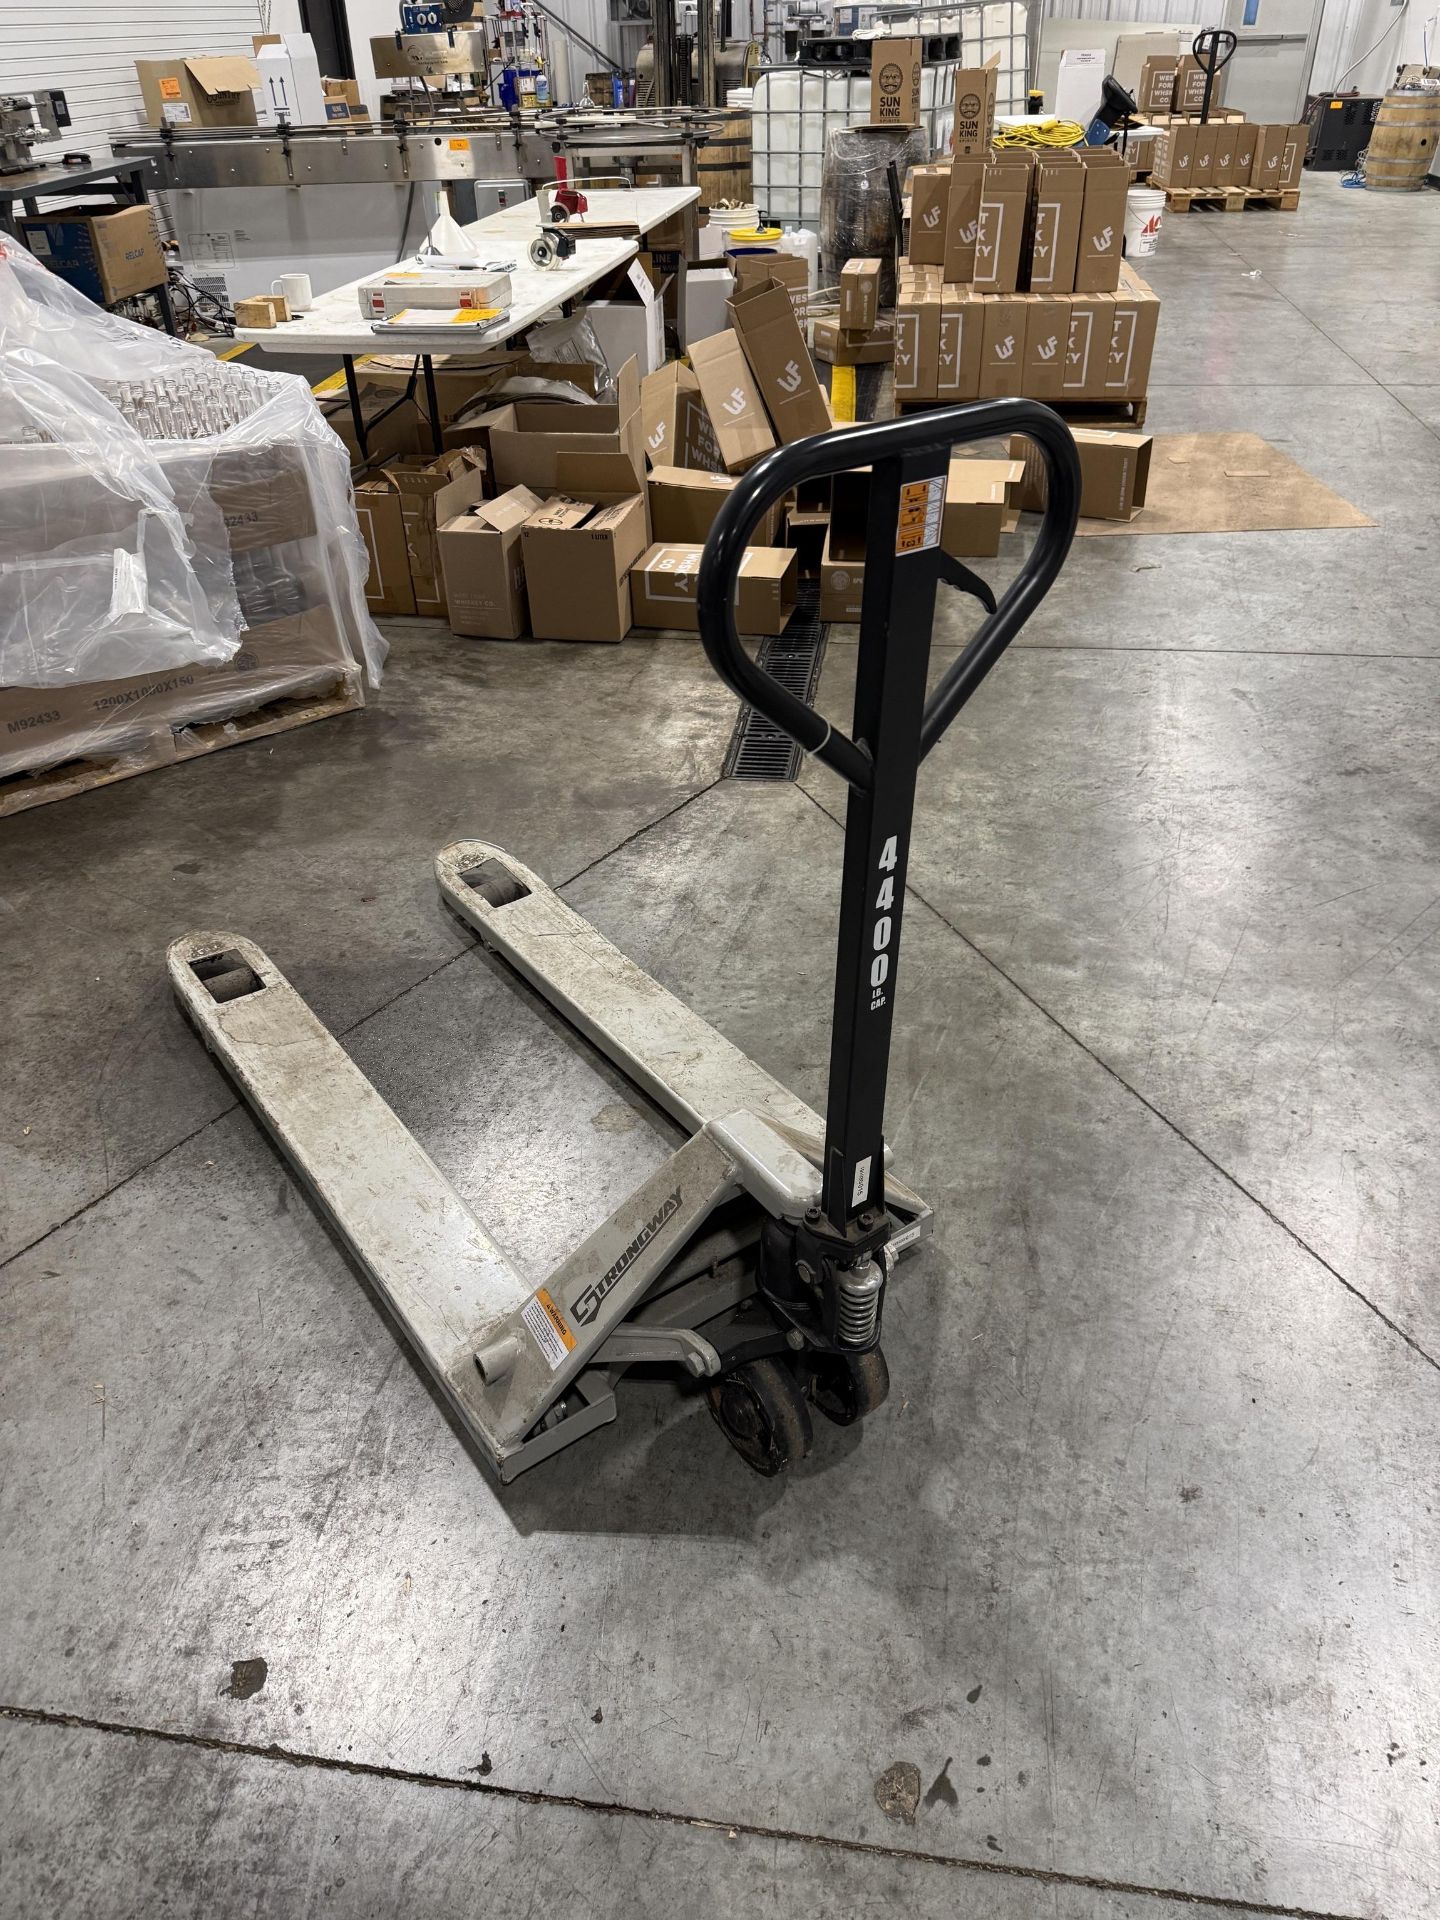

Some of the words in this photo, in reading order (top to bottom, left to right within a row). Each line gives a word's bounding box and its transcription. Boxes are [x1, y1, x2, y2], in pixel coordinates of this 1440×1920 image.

[880, 97, 900, 107] SUN
[880, 108, 900, 117] KING
[960, 121, 978, 129] SUN
[224, 511, 258, 527] 92433
[7, 710, 62, 735] M92433
[870, 835, 898, 987] 4400
[872, 987, 884, 999] LB.
[870, 996, 886, 1011] CAP.
[569, 1185, 684, 1328] STRONGWAY
[549, 1308, 568, 1336] WARNING
